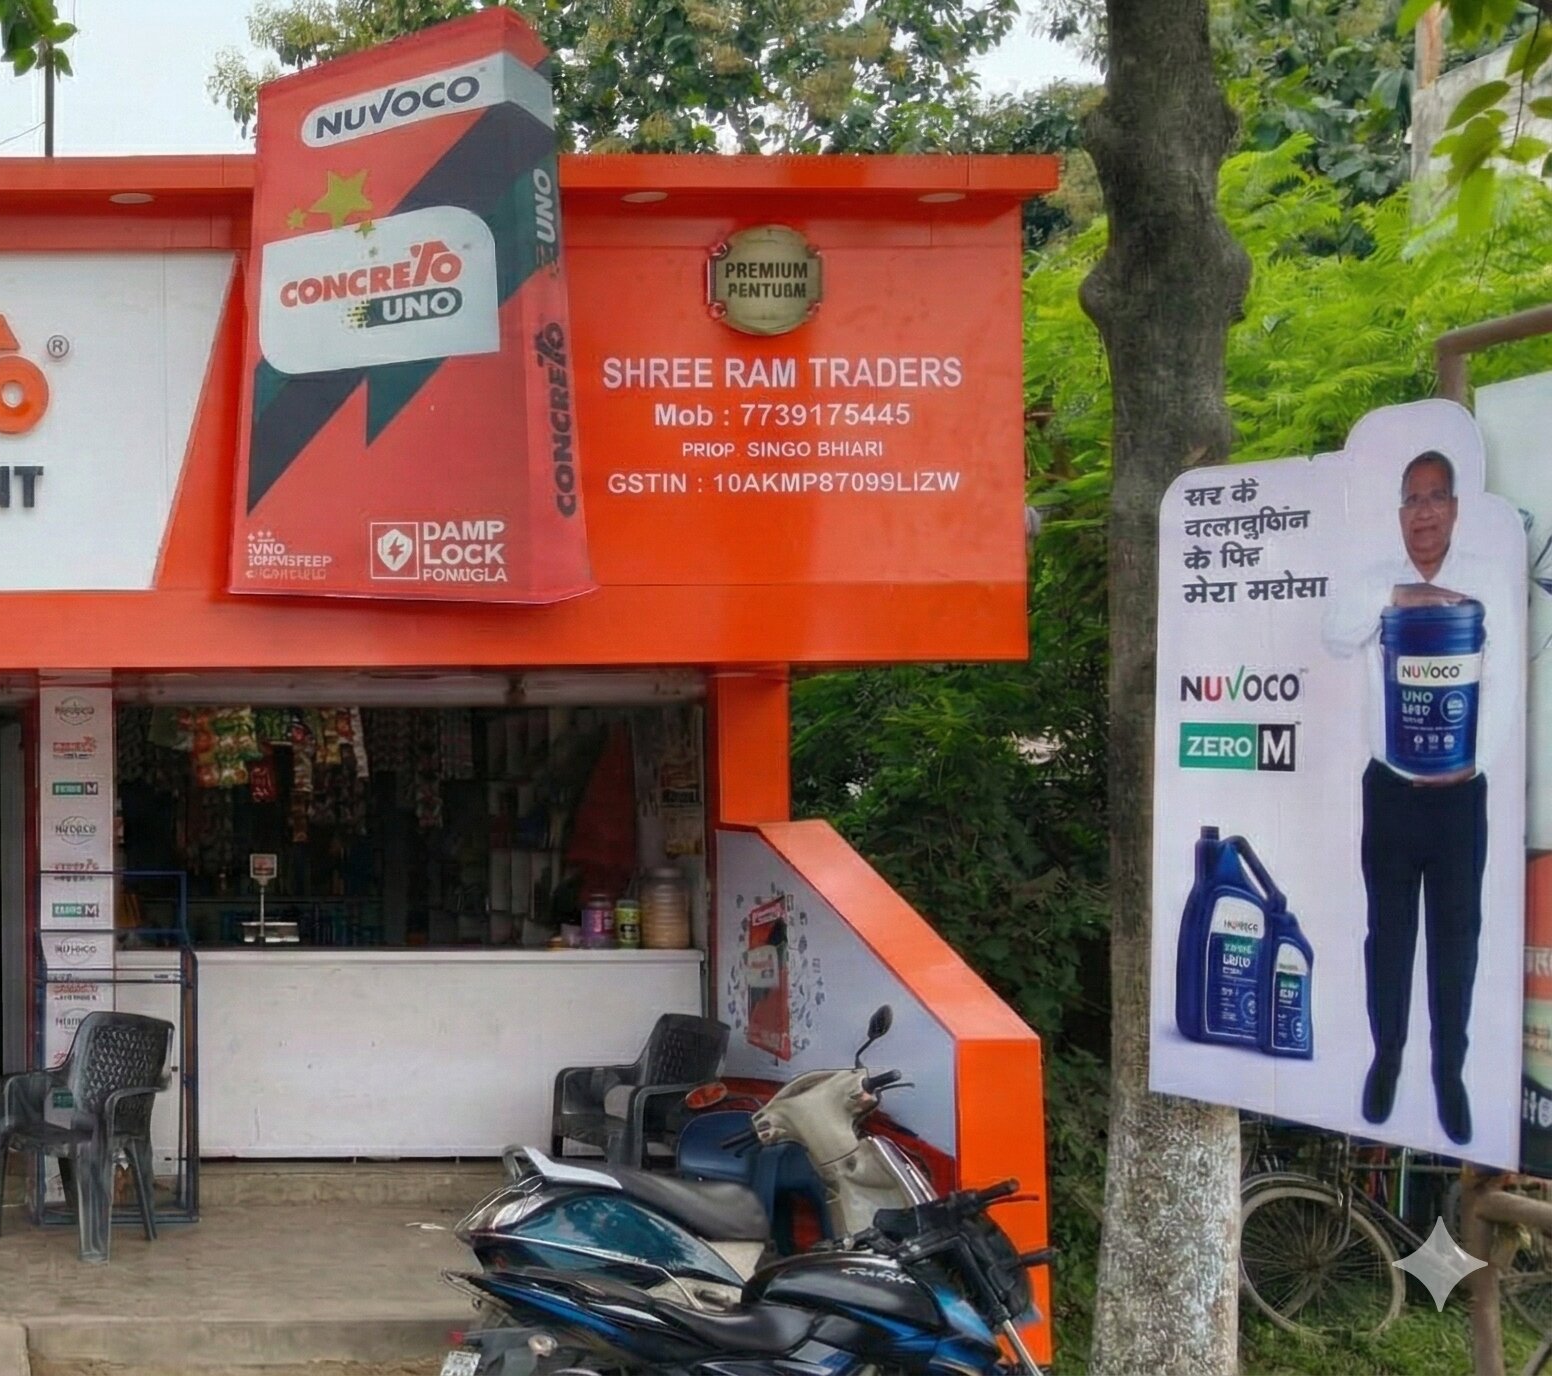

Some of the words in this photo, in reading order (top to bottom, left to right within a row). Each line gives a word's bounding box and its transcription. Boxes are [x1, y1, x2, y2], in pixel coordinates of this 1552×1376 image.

[315, 76, 480, 139] NUVOCO
[533, 168, 556, 244] UNO
[279, 240, 463, 309] CONCRETO
[725, 262, 808, 279] PREMIUM
[382, 290, 458, 322] UNO
[603, 357, 713, 389] SHREE
[725, 357, 797, 389] RAM
[808, 357, 963, 389] TRADERS
[535, 322, 577, 518] CONCRETO
[654, 403, 713, 427] Mob
[740, 403, 911, 427] 7739175445
[747, 441, 812, 458] SINGO
[817, 441, 884, 458] BHIARI
[607, 473, 687, 494] GSTIN
[423, 520, 505, 541] DAMP
[423, 543, 506, 565] LOCK
[1180, 665, 1300, 702] NUVOCO
[1401, 662, 1460, 679] NUVOCO
[1402, 690, 1434, 703] UNO
[1186, 736, 1253, 758] ZERO
[1261, 730, 1292, 765] M
